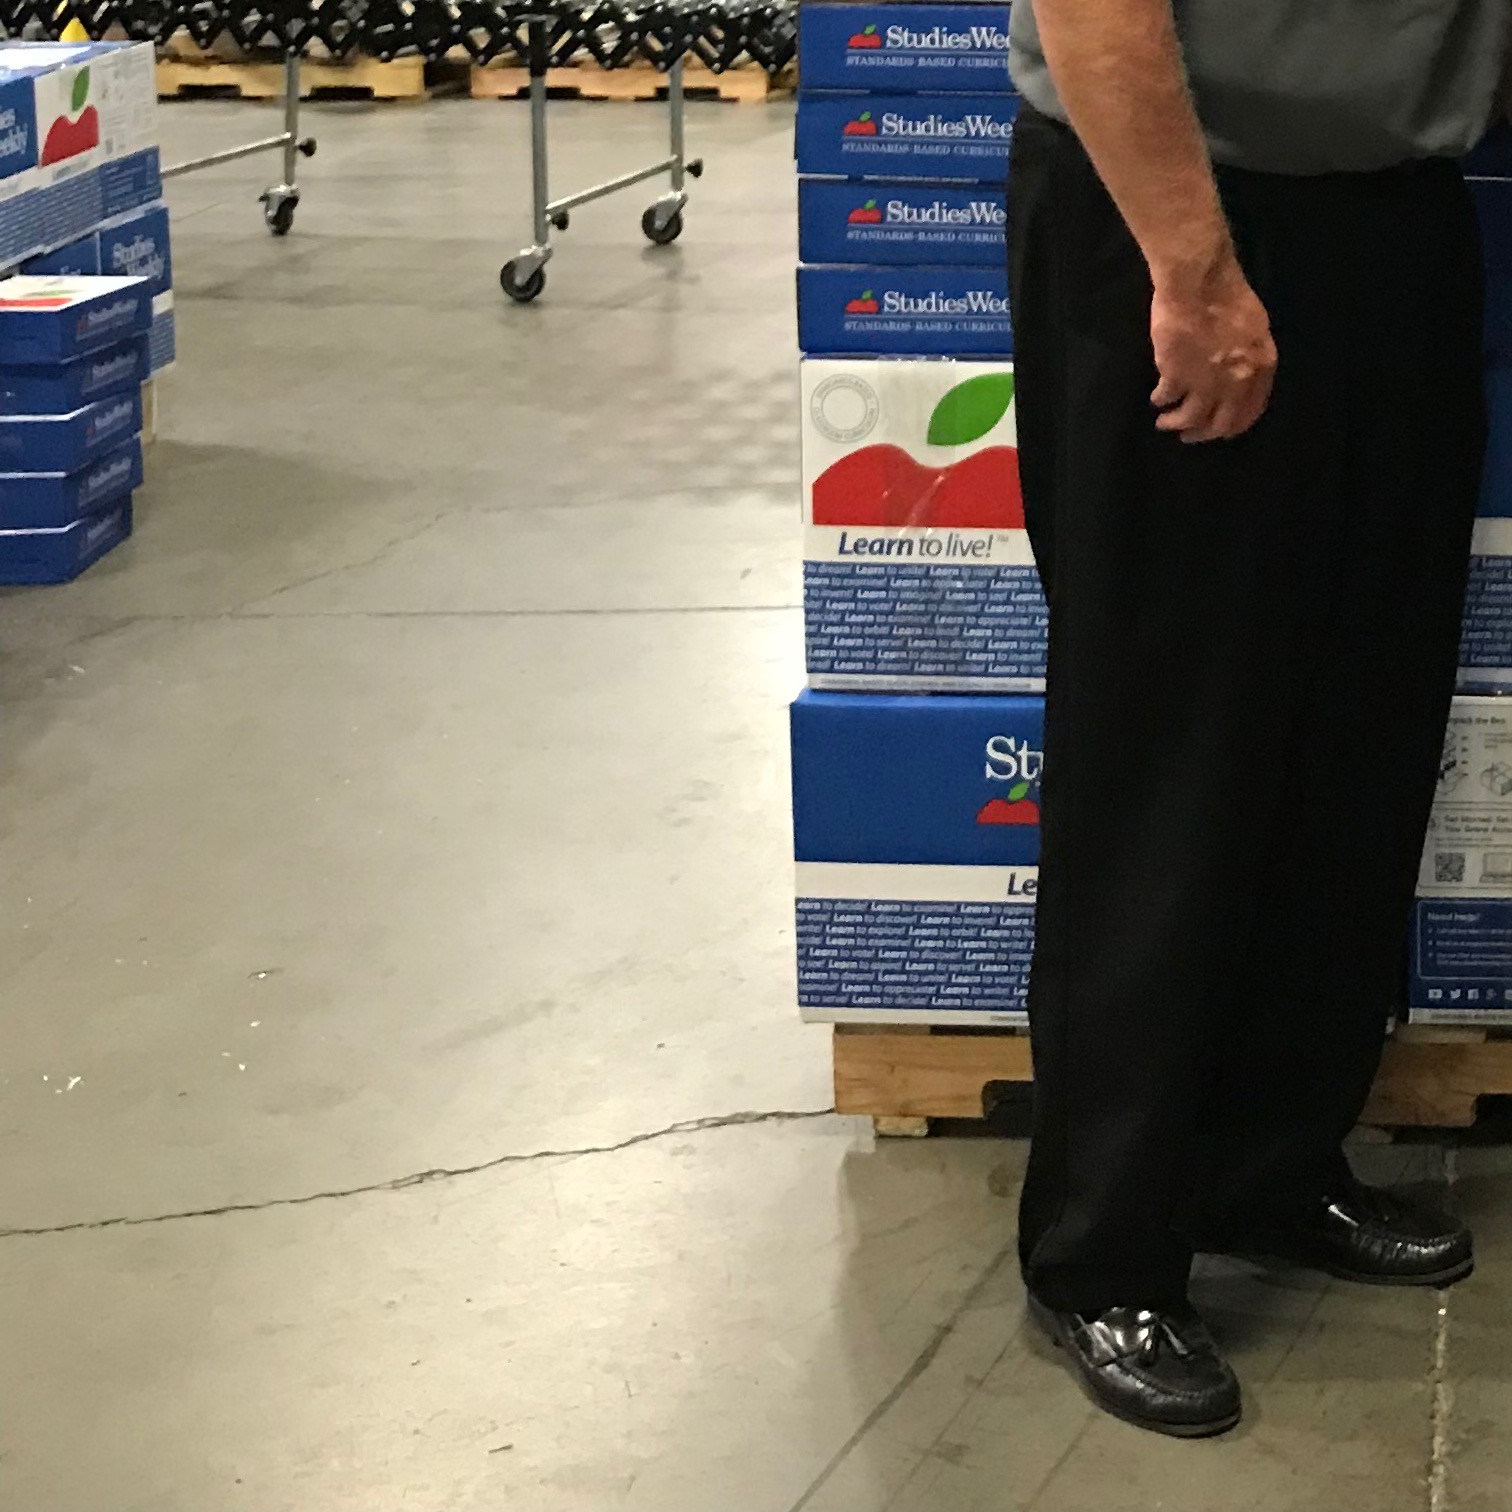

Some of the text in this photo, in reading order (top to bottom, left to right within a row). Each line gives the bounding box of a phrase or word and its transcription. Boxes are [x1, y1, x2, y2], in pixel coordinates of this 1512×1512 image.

[881, 113, 1013, 137] StudiesWee
[886, 200, 1007, 224] StudiesWe
[838, 532, 993, 558] Learn to live!
[930, 565, 959, 575] Learn
[988, 640, 1017, 649] Learn
[966, 651, 995, 660] Learn
[921, 915, 950, 924] Learn
